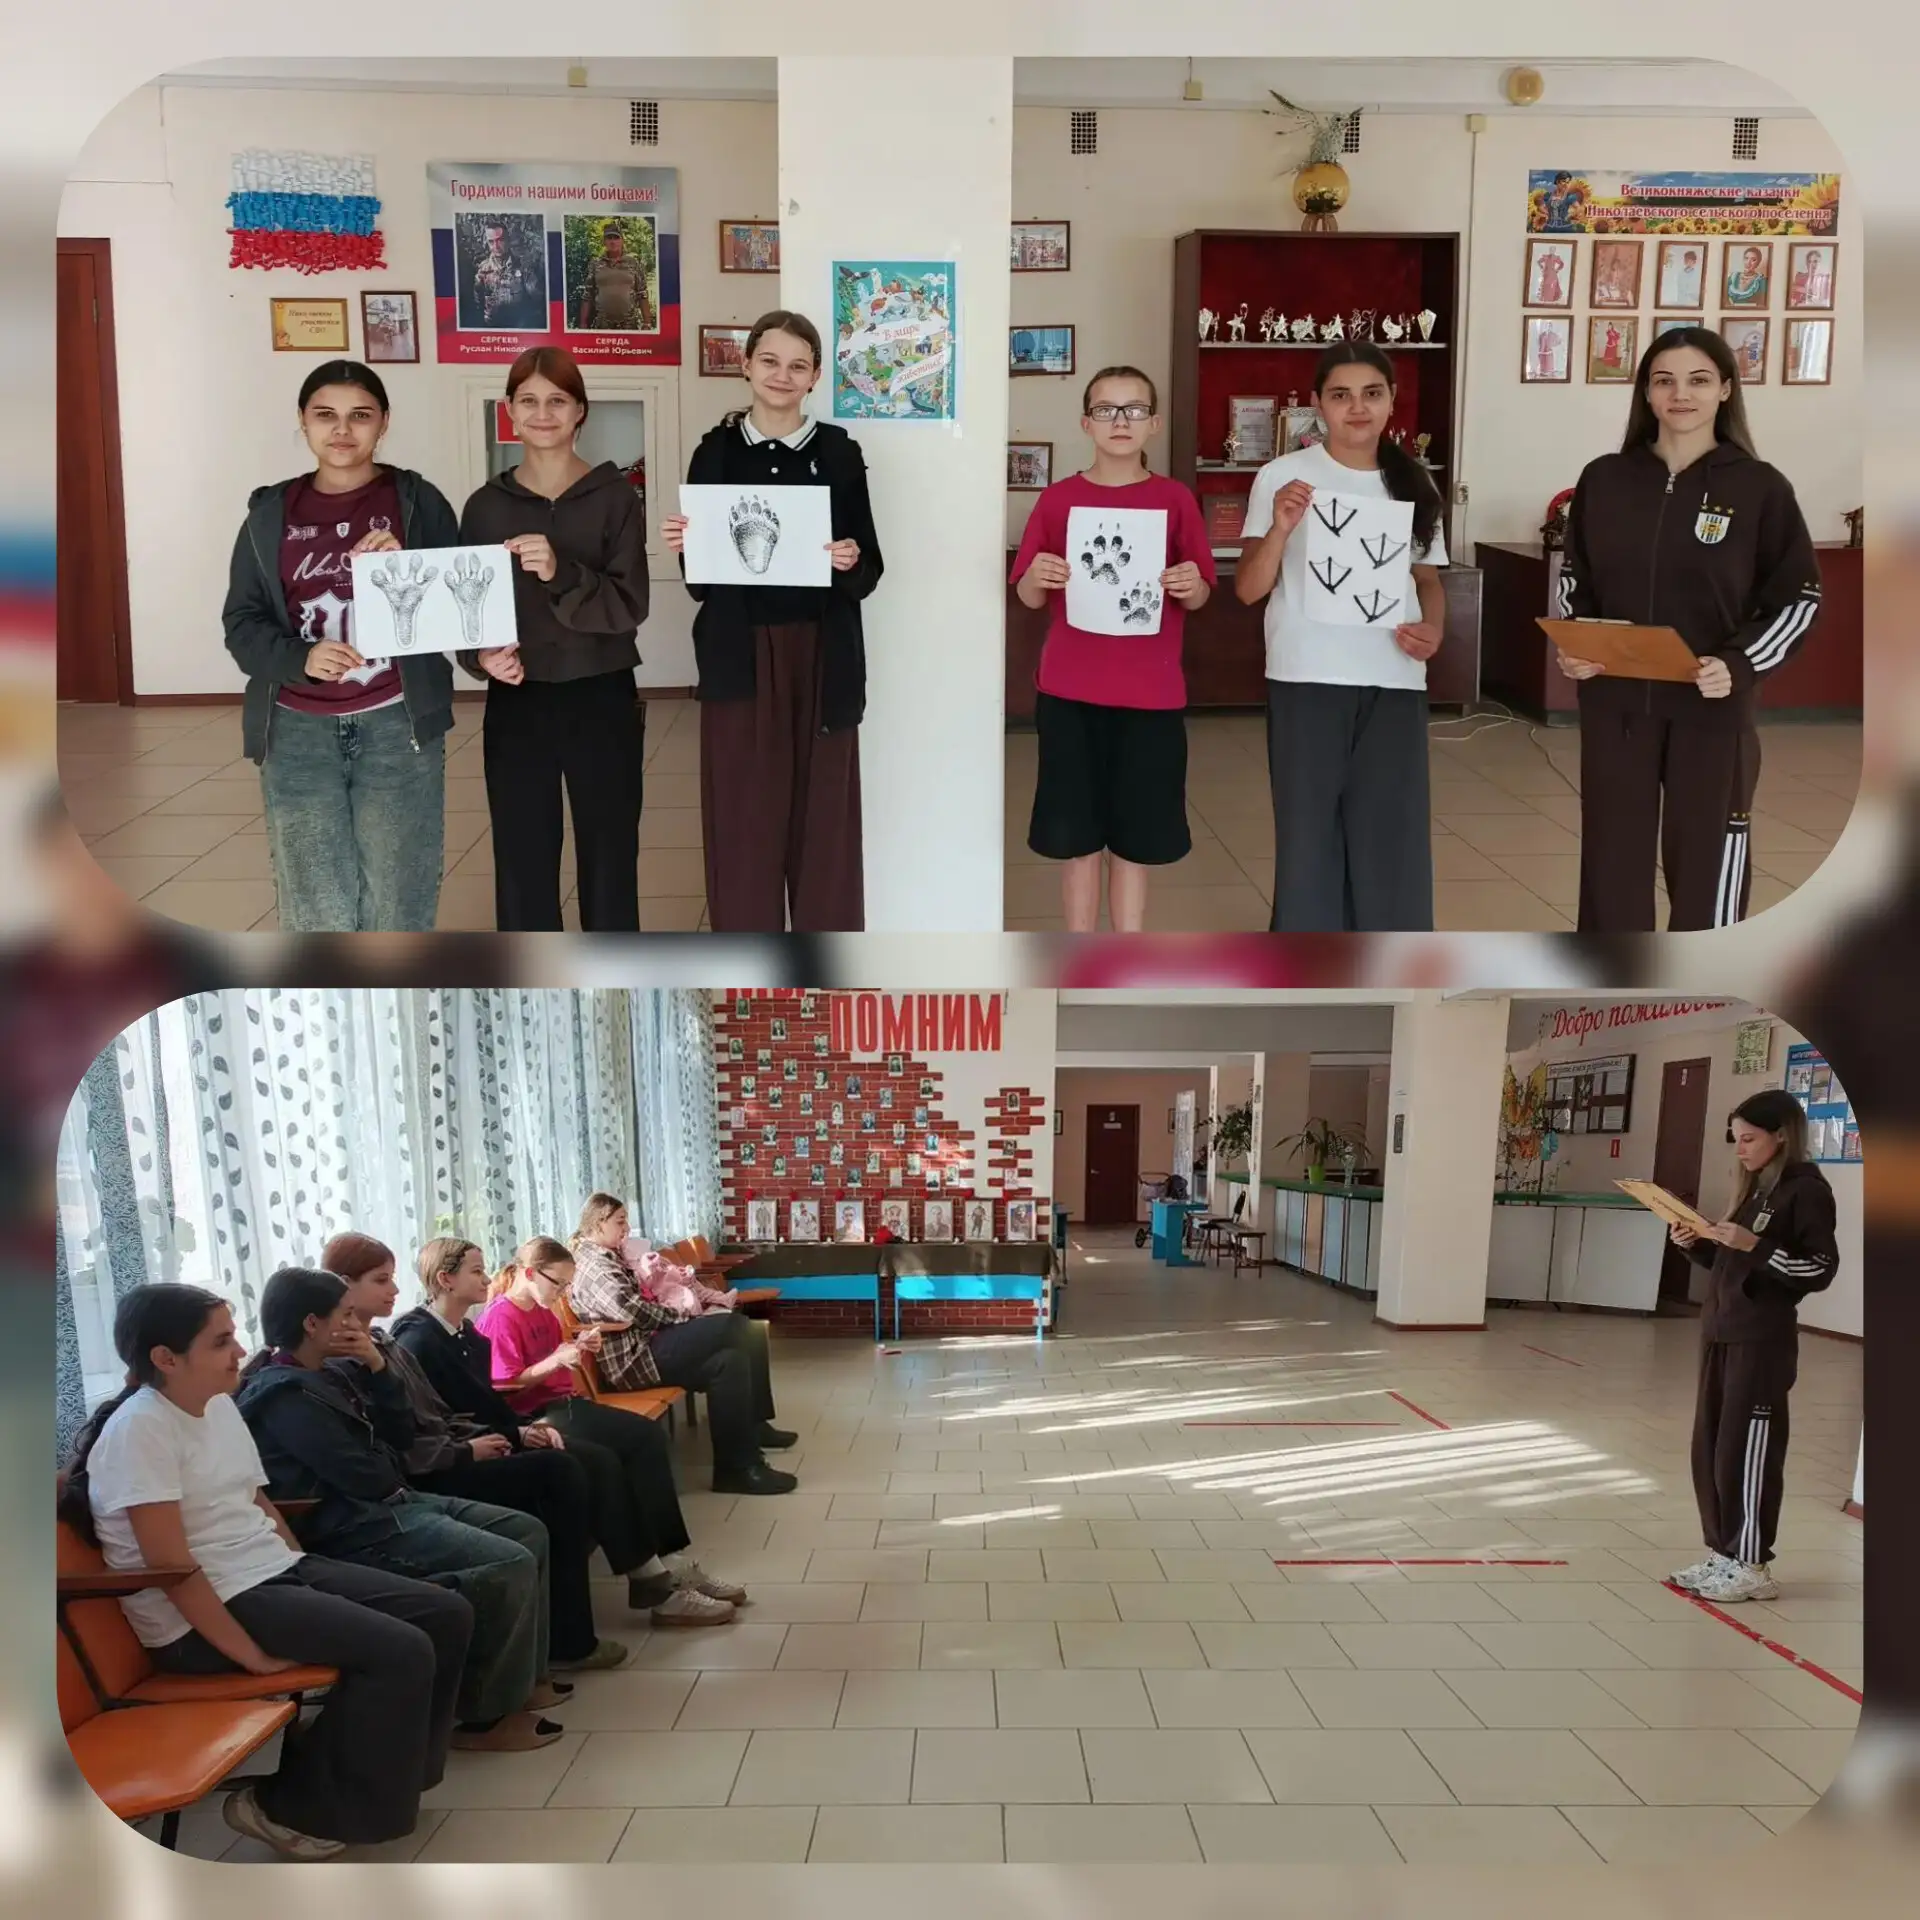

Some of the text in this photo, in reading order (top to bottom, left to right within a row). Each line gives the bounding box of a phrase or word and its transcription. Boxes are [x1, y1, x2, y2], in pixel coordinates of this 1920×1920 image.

[451, 180, 658, 203] Гордимся нашими бойцами!
[1621, 184, 1742, 197] Великокняжеские
[1587, 205, 1831, 219] Николаевского сельского поселения
[480, 336, 518, 344] СЕРГЕЕВ
[595, 338, 630, 346] СЕРЕДА
[460, 344, 492, 353] Руслан
[572, 346, 652, 356] Василий Юрьевич
[831, 993, 1002, 1052] ПОМНИМ
[1551, 1005, 1604, 1046] Добро
